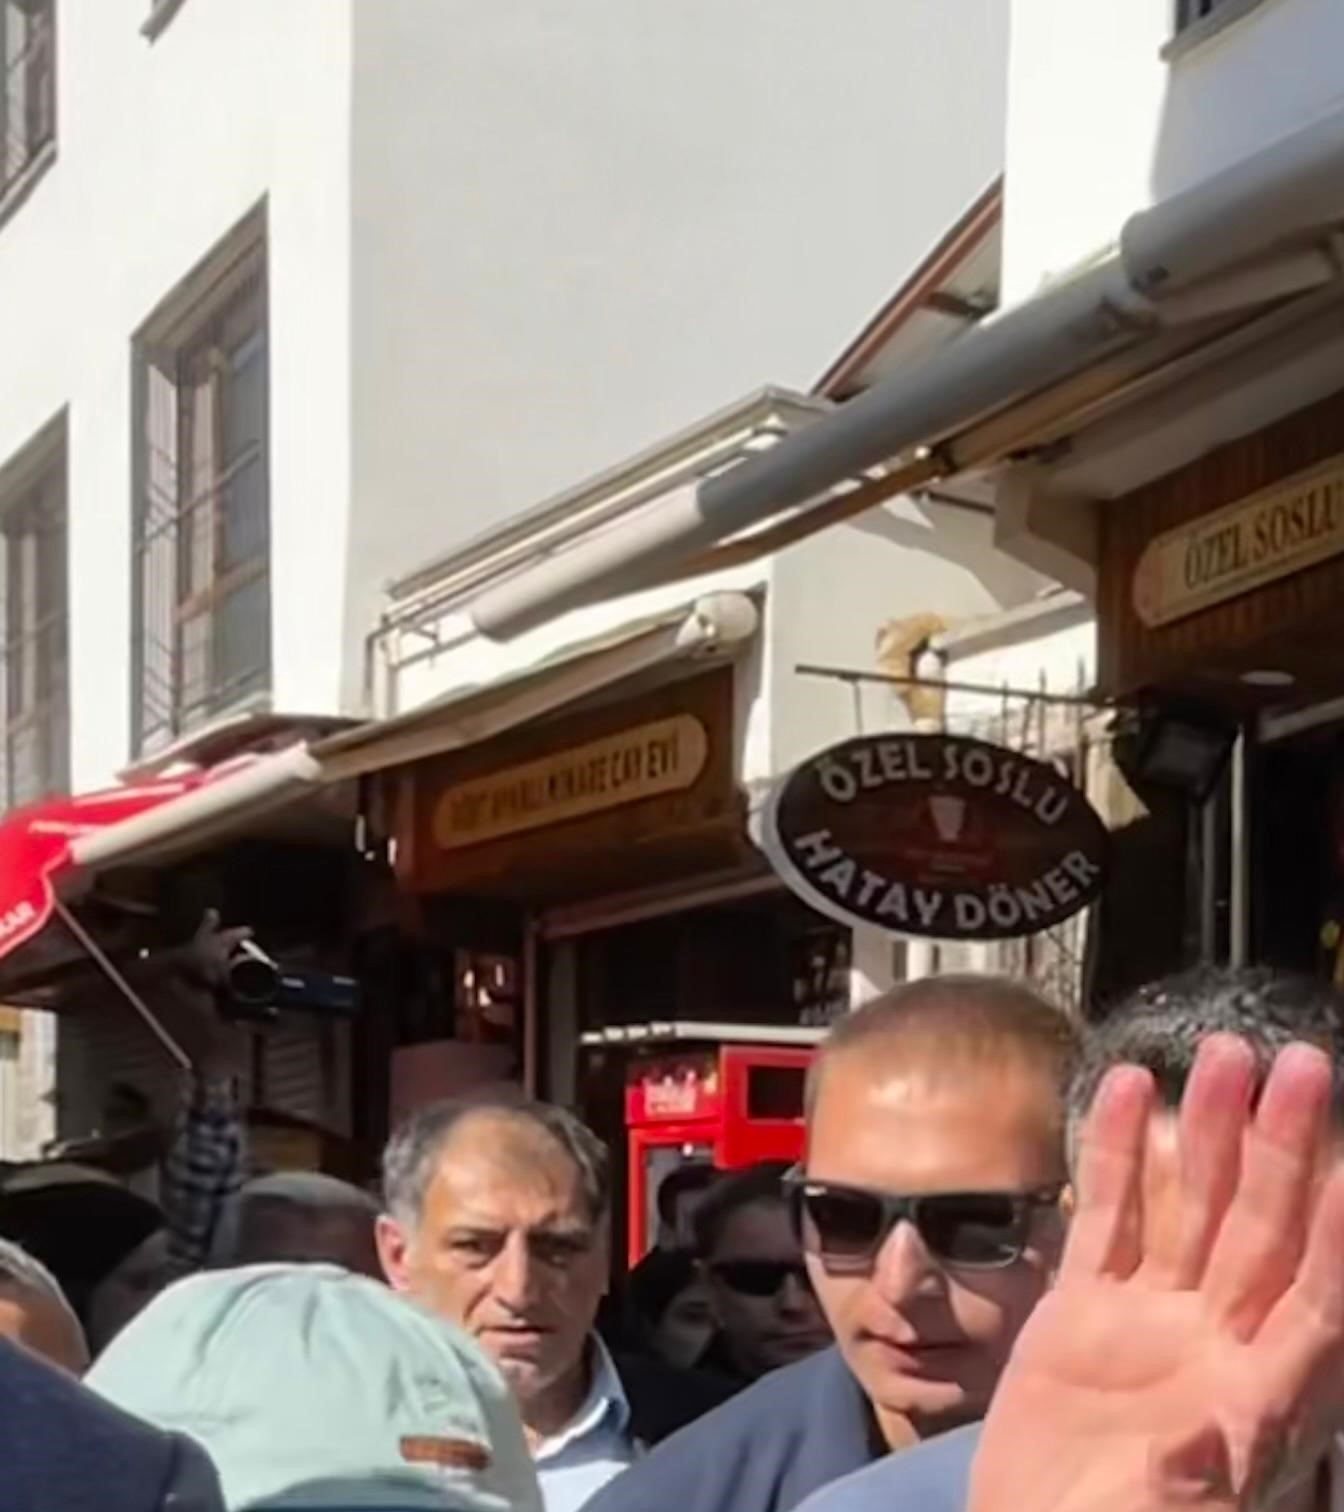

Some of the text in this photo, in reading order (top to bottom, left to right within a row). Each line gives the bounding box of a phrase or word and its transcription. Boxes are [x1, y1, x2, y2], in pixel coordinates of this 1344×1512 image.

[1252, 479, 1344, 570] SOSLU
[814, 740, 1070, 826] ÖZEL SOSLU
[793, 827, 942, 927] HATAY
[952, 849, 1101, 931] DÖNER
